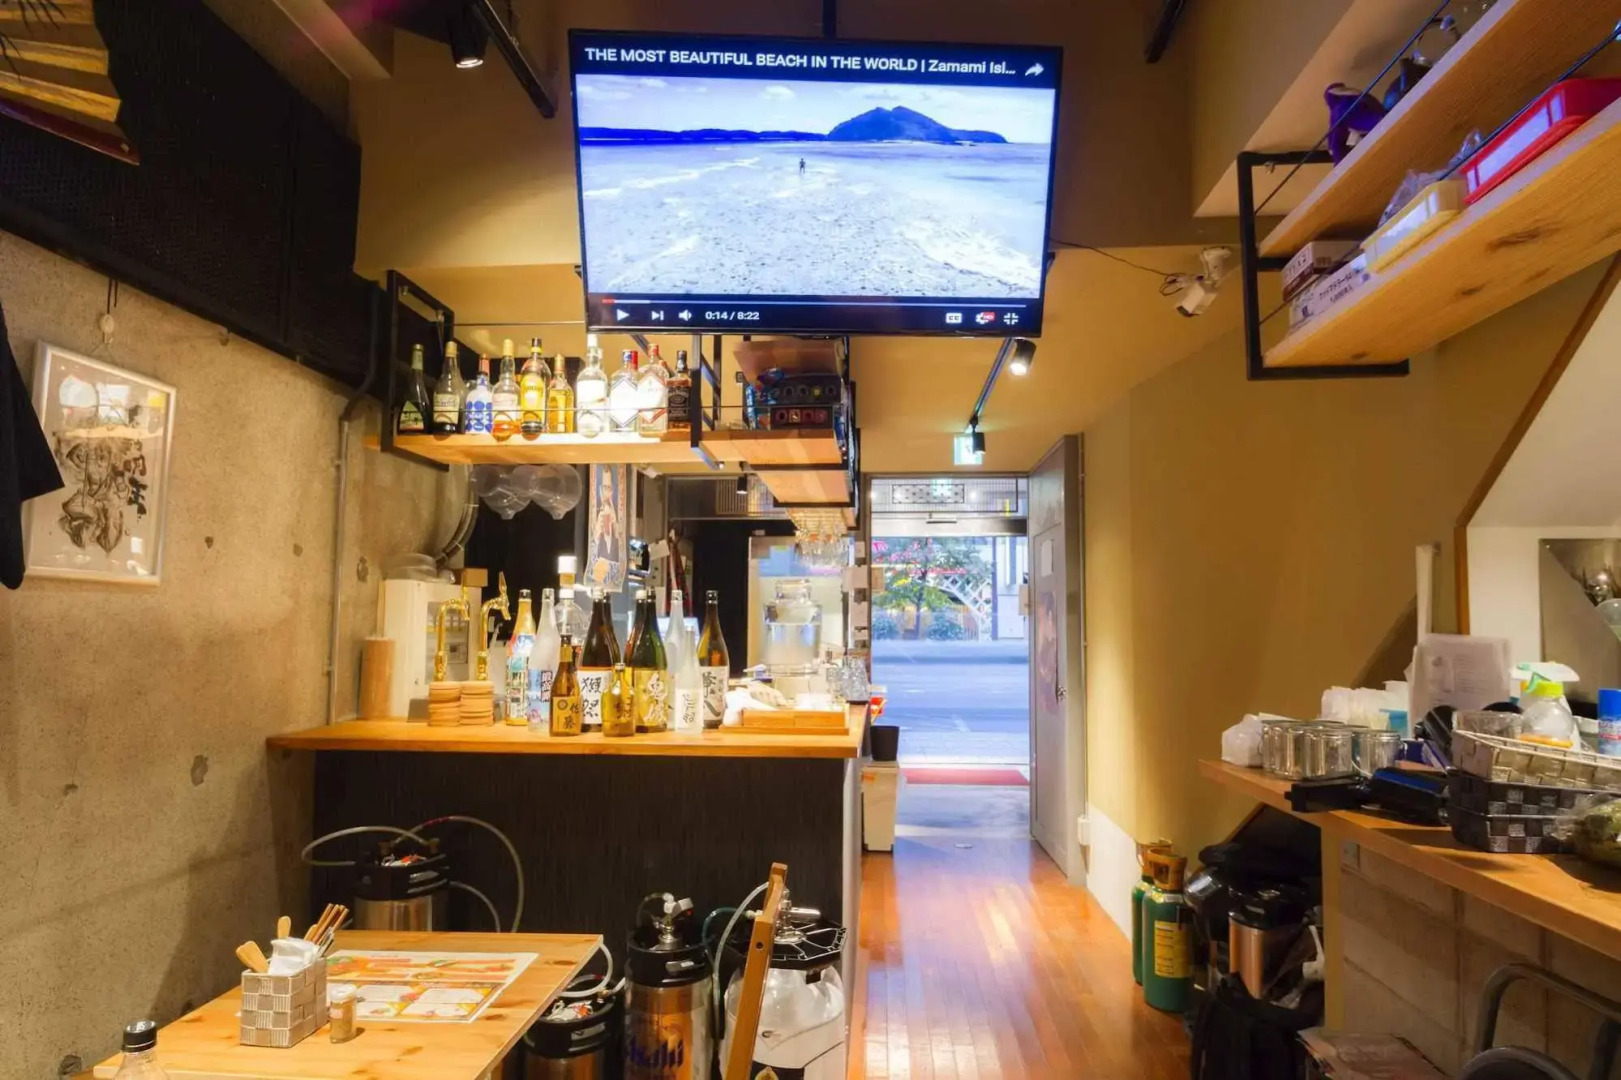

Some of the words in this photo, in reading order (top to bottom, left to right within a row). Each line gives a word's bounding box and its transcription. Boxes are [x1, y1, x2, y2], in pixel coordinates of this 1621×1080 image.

[584, 47, 617, 61] THE
[620, 49, 666, 62] MOST
[669, 51, 752, 65] BEAUTIFUL
[756, 53, 807, 67] BEACH
[811, 55, 827, 68] IN
[830, 56, 861, 69] THE
[864, 57, 918, 71] WORLD
[928, 59, 987, 73] Zamami
[705, 311, 728, 320] 0:14
[737, 311, 760, 320] 8:22
[581, 676, 602, 718] 獺祭
